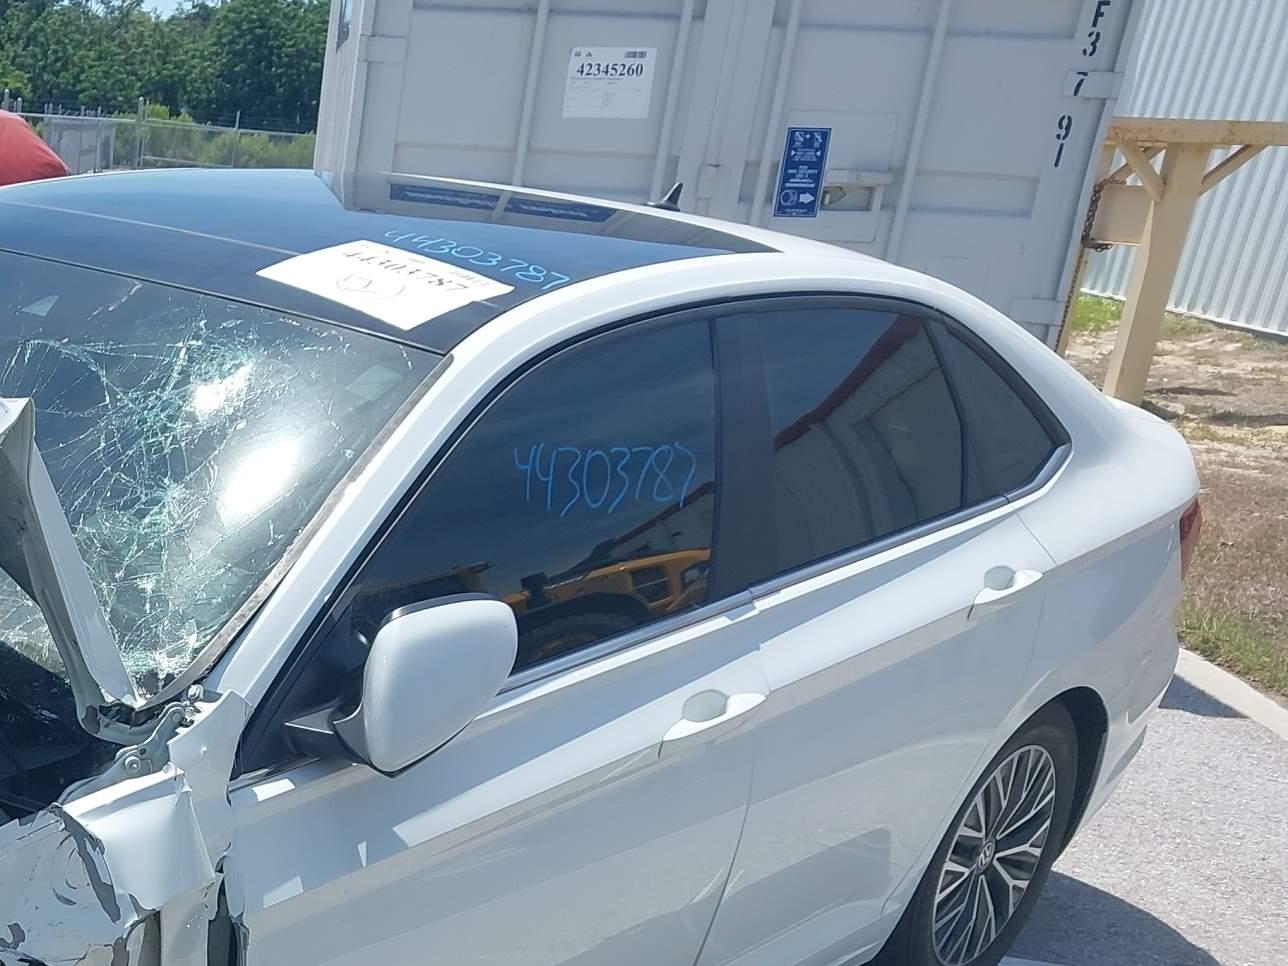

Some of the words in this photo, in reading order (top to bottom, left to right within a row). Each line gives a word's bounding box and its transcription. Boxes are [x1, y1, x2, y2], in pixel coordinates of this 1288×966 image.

[576, 62, 644, 77] 42345260
[383, 229, 571, 291] 44303787
[514, 441, 697, 518] 44303787
